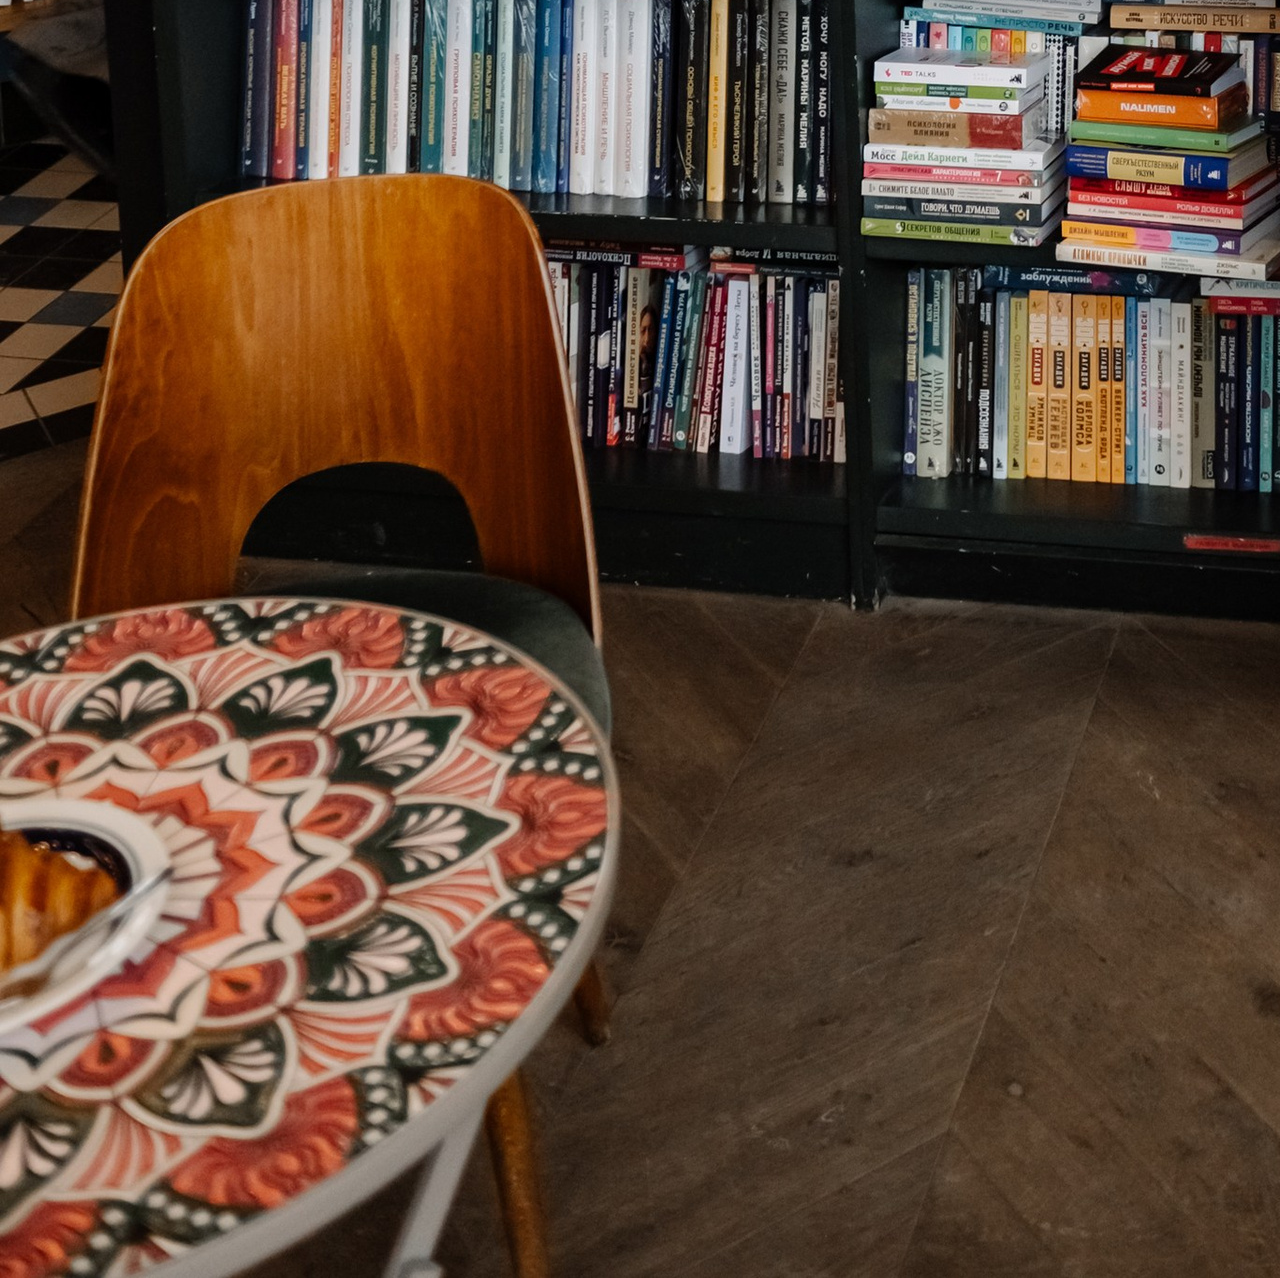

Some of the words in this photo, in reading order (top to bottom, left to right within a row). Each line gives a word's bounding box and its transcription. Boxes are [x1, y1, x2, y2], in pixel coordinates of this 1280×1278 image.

[777, 11, 788, 46] СКАЖИ
[800, 16, 809, 52] МЕТОД
[820, 16, 828, 44] ХОЧУ
[777, 48, 788, 71] СЕБЕ
[819, 51, 828, 80] МОГУ
[776, 74, 788, 104] «ДА!»
[800, 59, 809, 105] МАРИНЫ
[818, 87, 827, 118] НАДО
[1120, 101, 1176, 114] NAUMEN
[799, 112, 808, 148] МЕЛИЯ
[901, 152, 922, 162] Дейл
[925, 153, 968, 164] Карнеги
[629, 276, 639, 337] поведение
[627, 349, 638, 404] Ценности
